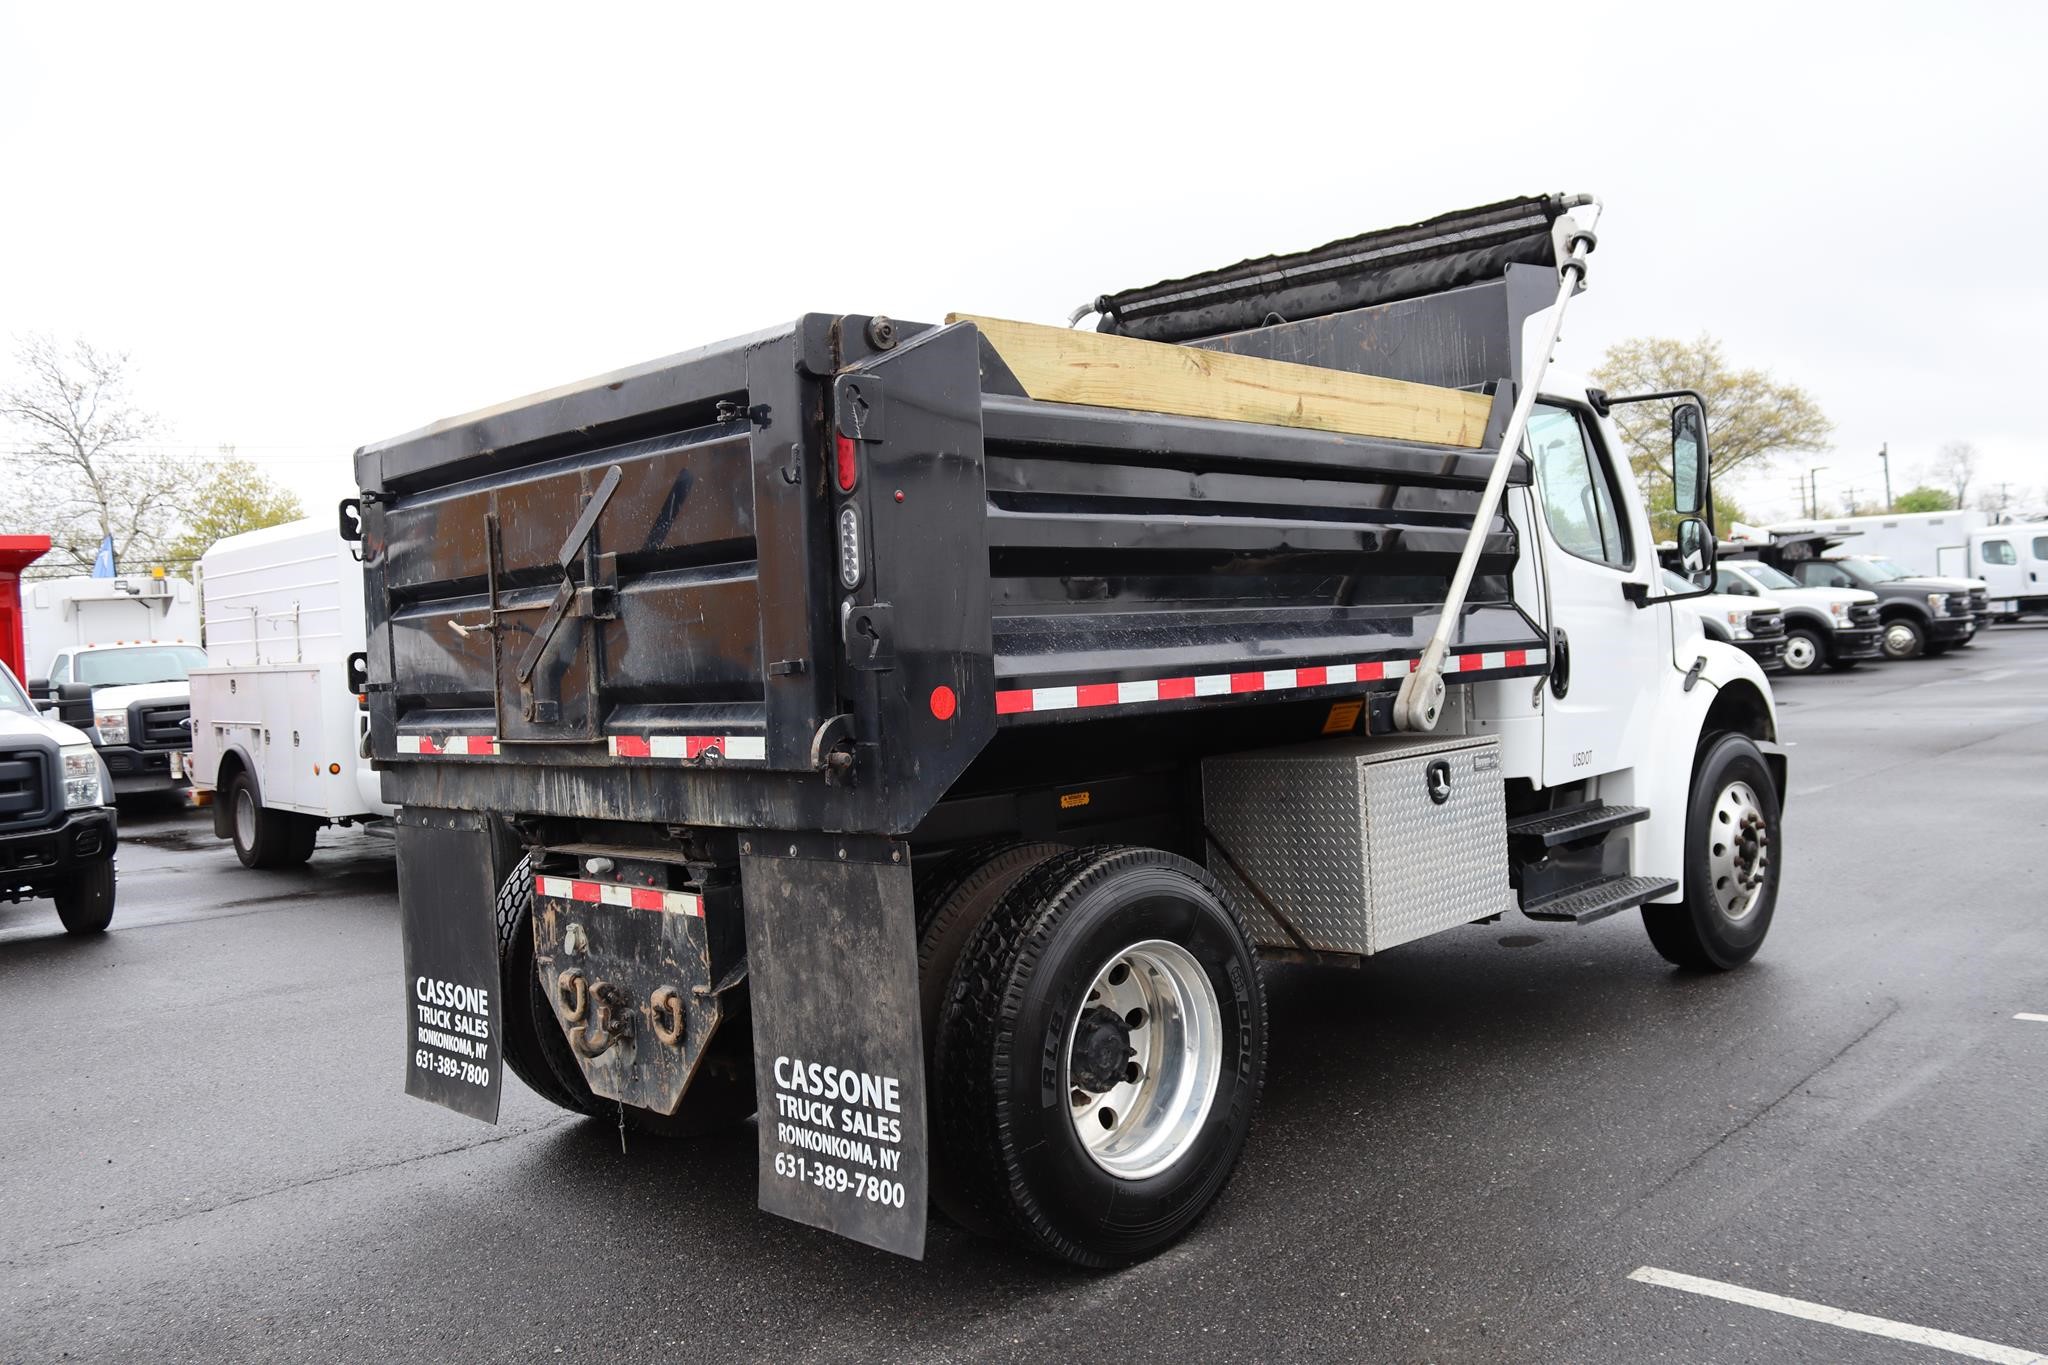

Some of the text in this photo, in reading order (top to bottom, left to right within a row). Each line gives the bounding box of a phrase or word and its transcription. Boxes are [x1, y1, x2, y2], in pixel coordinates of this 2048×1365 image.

[1572, 750, 1593, 768] USDOT
[416, 976, 489, 1017] CASSONE
[417, 1004, 489, 1039] TRUCK SALES
[418, 1027, 488, 1060] RONKONKOMA, NY
[416, 1049, 490, 1088] 631-389-7800
[774, 1056, 901, 1114] CASSONE
[776, 1093, 902, 1144] TRUCK SALES
[778, 1122, 901, 1172] RONKONKOMA, NY
[775, 1152, 906, 1209] 631-389-7800
